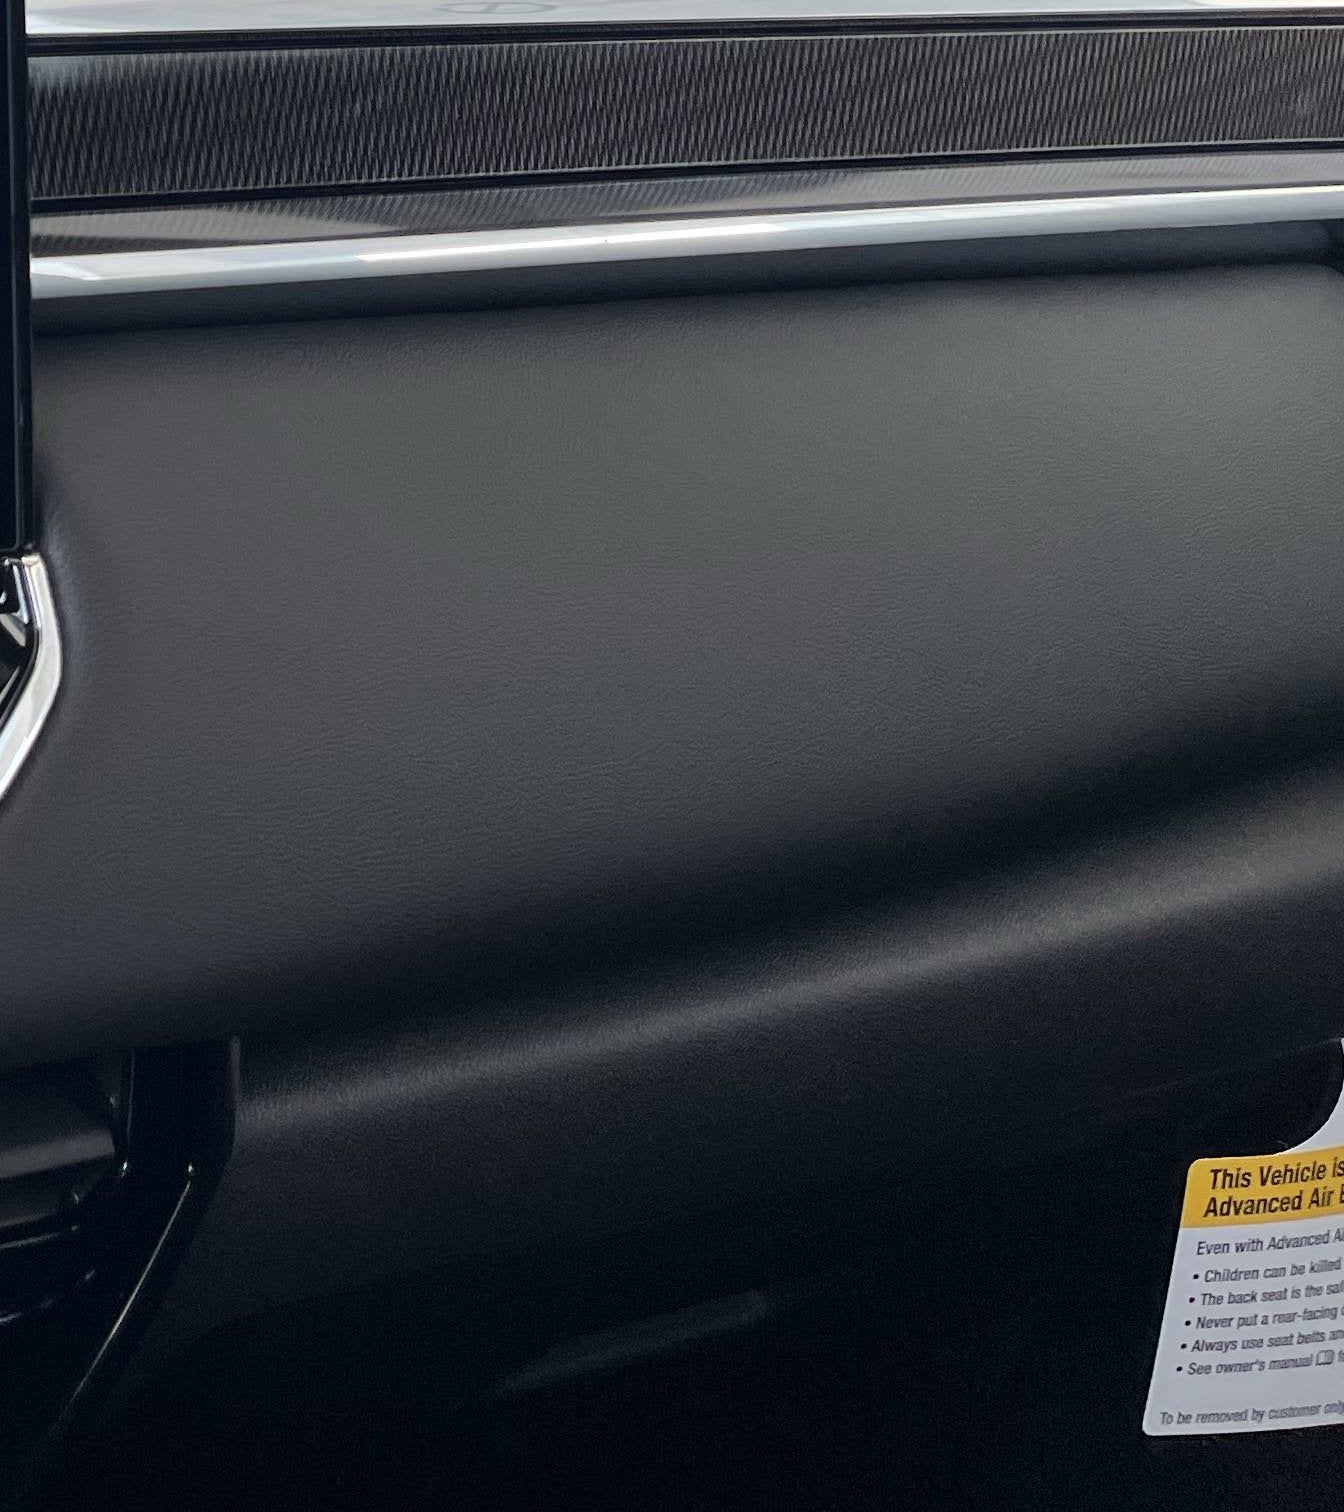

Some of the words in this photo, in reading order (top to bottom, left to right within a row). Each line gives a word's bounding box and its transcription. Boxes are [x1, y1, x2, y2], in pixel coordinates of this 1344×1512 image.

[1211, 1167, 1252, 1190] This
[1259, 1161, 1327, 1187] Vehicle
[1203, 1189, 1303, 1218] Advanced
[1308, 1185, 1334, 1210] Air
[1196, 1240, 1230, 1256] Even
[1235, 1238, 1263, 1253] with
[1266, 1230, 1330, 1251] Advanced
[1205, 1268, 1259, 1283] Children
[1263, 1266, 1287, 1278] can
[1290, 1263, 1305, 1276] be
[1309, 1257, 1342, 1273] killed
[1200, 1292, 1224, 1306] The
[1227, 1290, 1257, 1304] back
[1261, 1287, 1288, 1302] seat
[1291, 1287, 1301, 1299] is
[1304, 1284, 1322, 1297] the
[1195, 1316, 1234, 1329] Never
[1236, 1314, 1257, 1329] put
[1261, 1315, 1269, 1326] a
[1272, 1306, 1338, 1324] rear-facing
[1191, 1339, 1237, 1353] Always
[1241, 1336, 1264, 1347] use
[1267, 1333, 1294, 1347] seat
[1296, 1330, 1326, 1345] belts
[1187, 1362, 1211, 1375] See
[1215, 1359, 1265, 1374] owner's
[1268, 1354, 1312, 1370] manual
[1160, 1412, 1174, 1426] To
[1177, 1411, 1192, 1425] be
[1196, 1409, 1247, 1424] removed
[1251, 1408, 1265, 1423] by
[1268, 1404, 1321, 1419] customer
